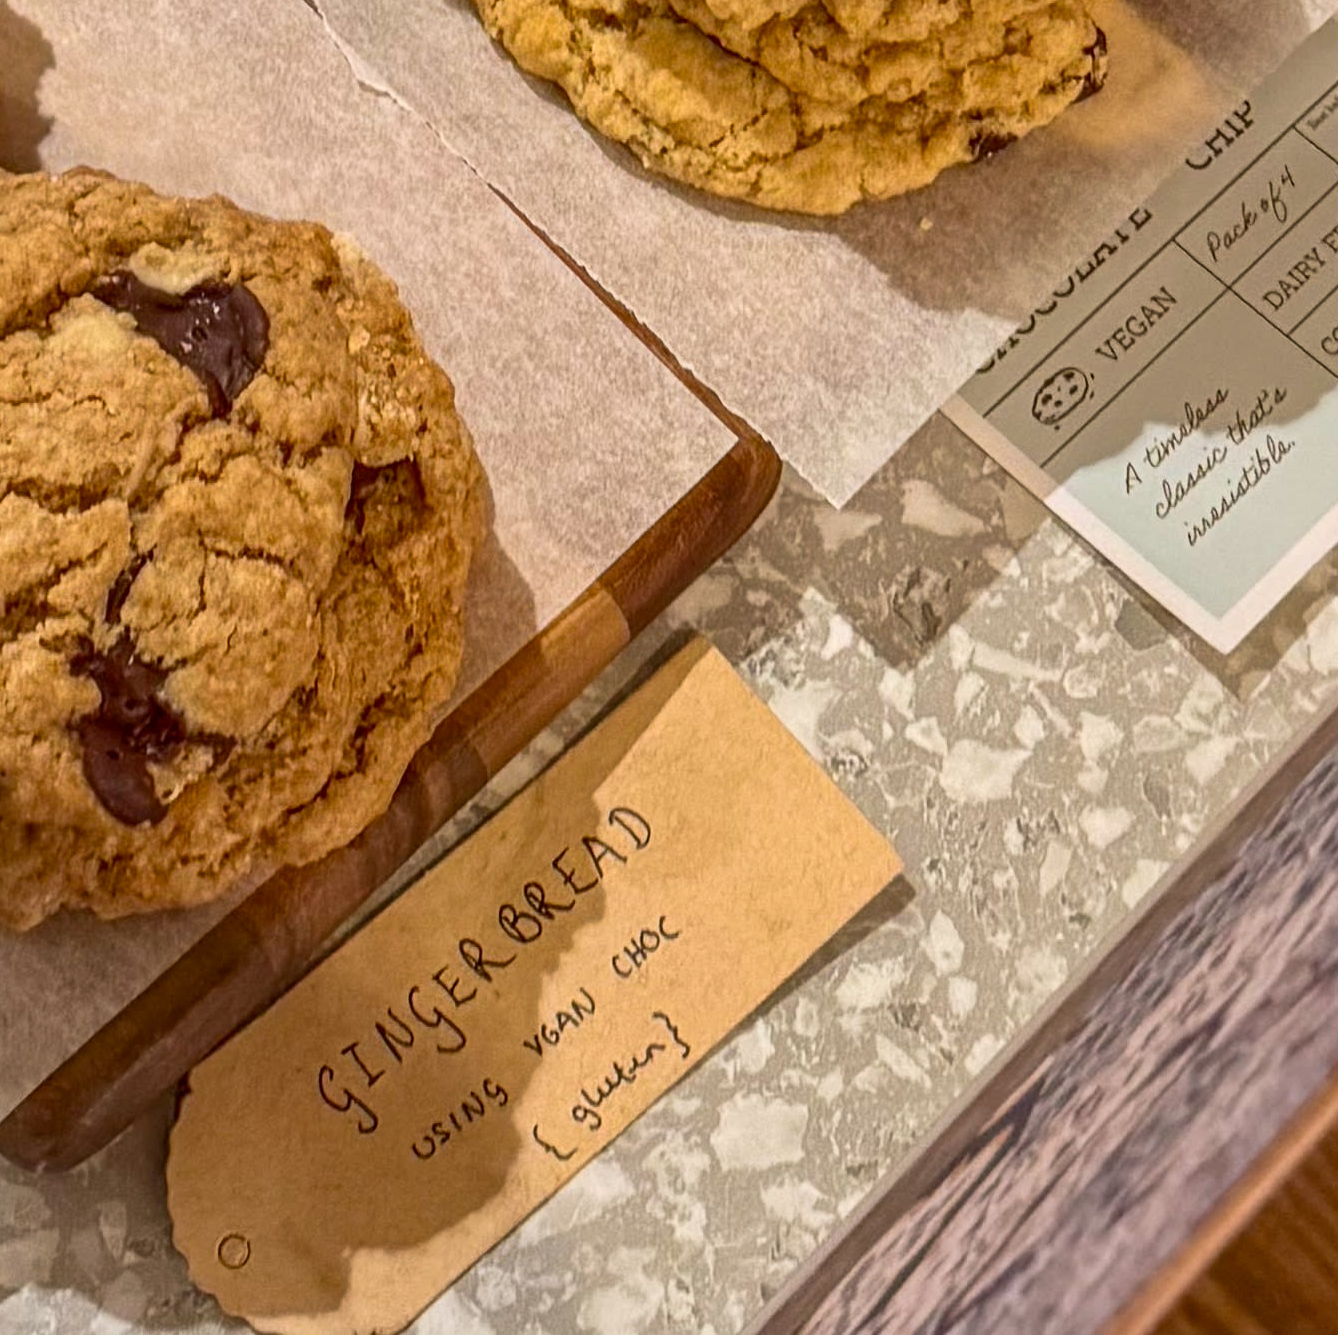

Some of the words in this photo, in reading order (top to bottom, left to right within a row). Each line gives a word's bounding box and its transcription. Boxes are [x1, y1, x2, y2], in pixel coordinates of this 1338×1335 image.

[1206, 201, 1258, 263] Pack
[1259, 180, 1290, 224] of
[1280, 163, 1296, 188] 4
[1095, 285, 1179, 364] VEGAN
[1262, 246, 1327, 312] DAIRY
[1125, 461, 1143, 495] A
[1143, 388, 1230, 468] timeless
[1155, 445, 1228, 520] classic
[1226, 386, 1288, 446] that's
[1184, 434, 1296, 547] irresistible.
[318, 806, 652, 1135] GINGERBREAD
[411, 1077, 509, 1161] USING
[523, 986, 597, 1058] VGAN
[611, 915, 681, 979] CHOC
